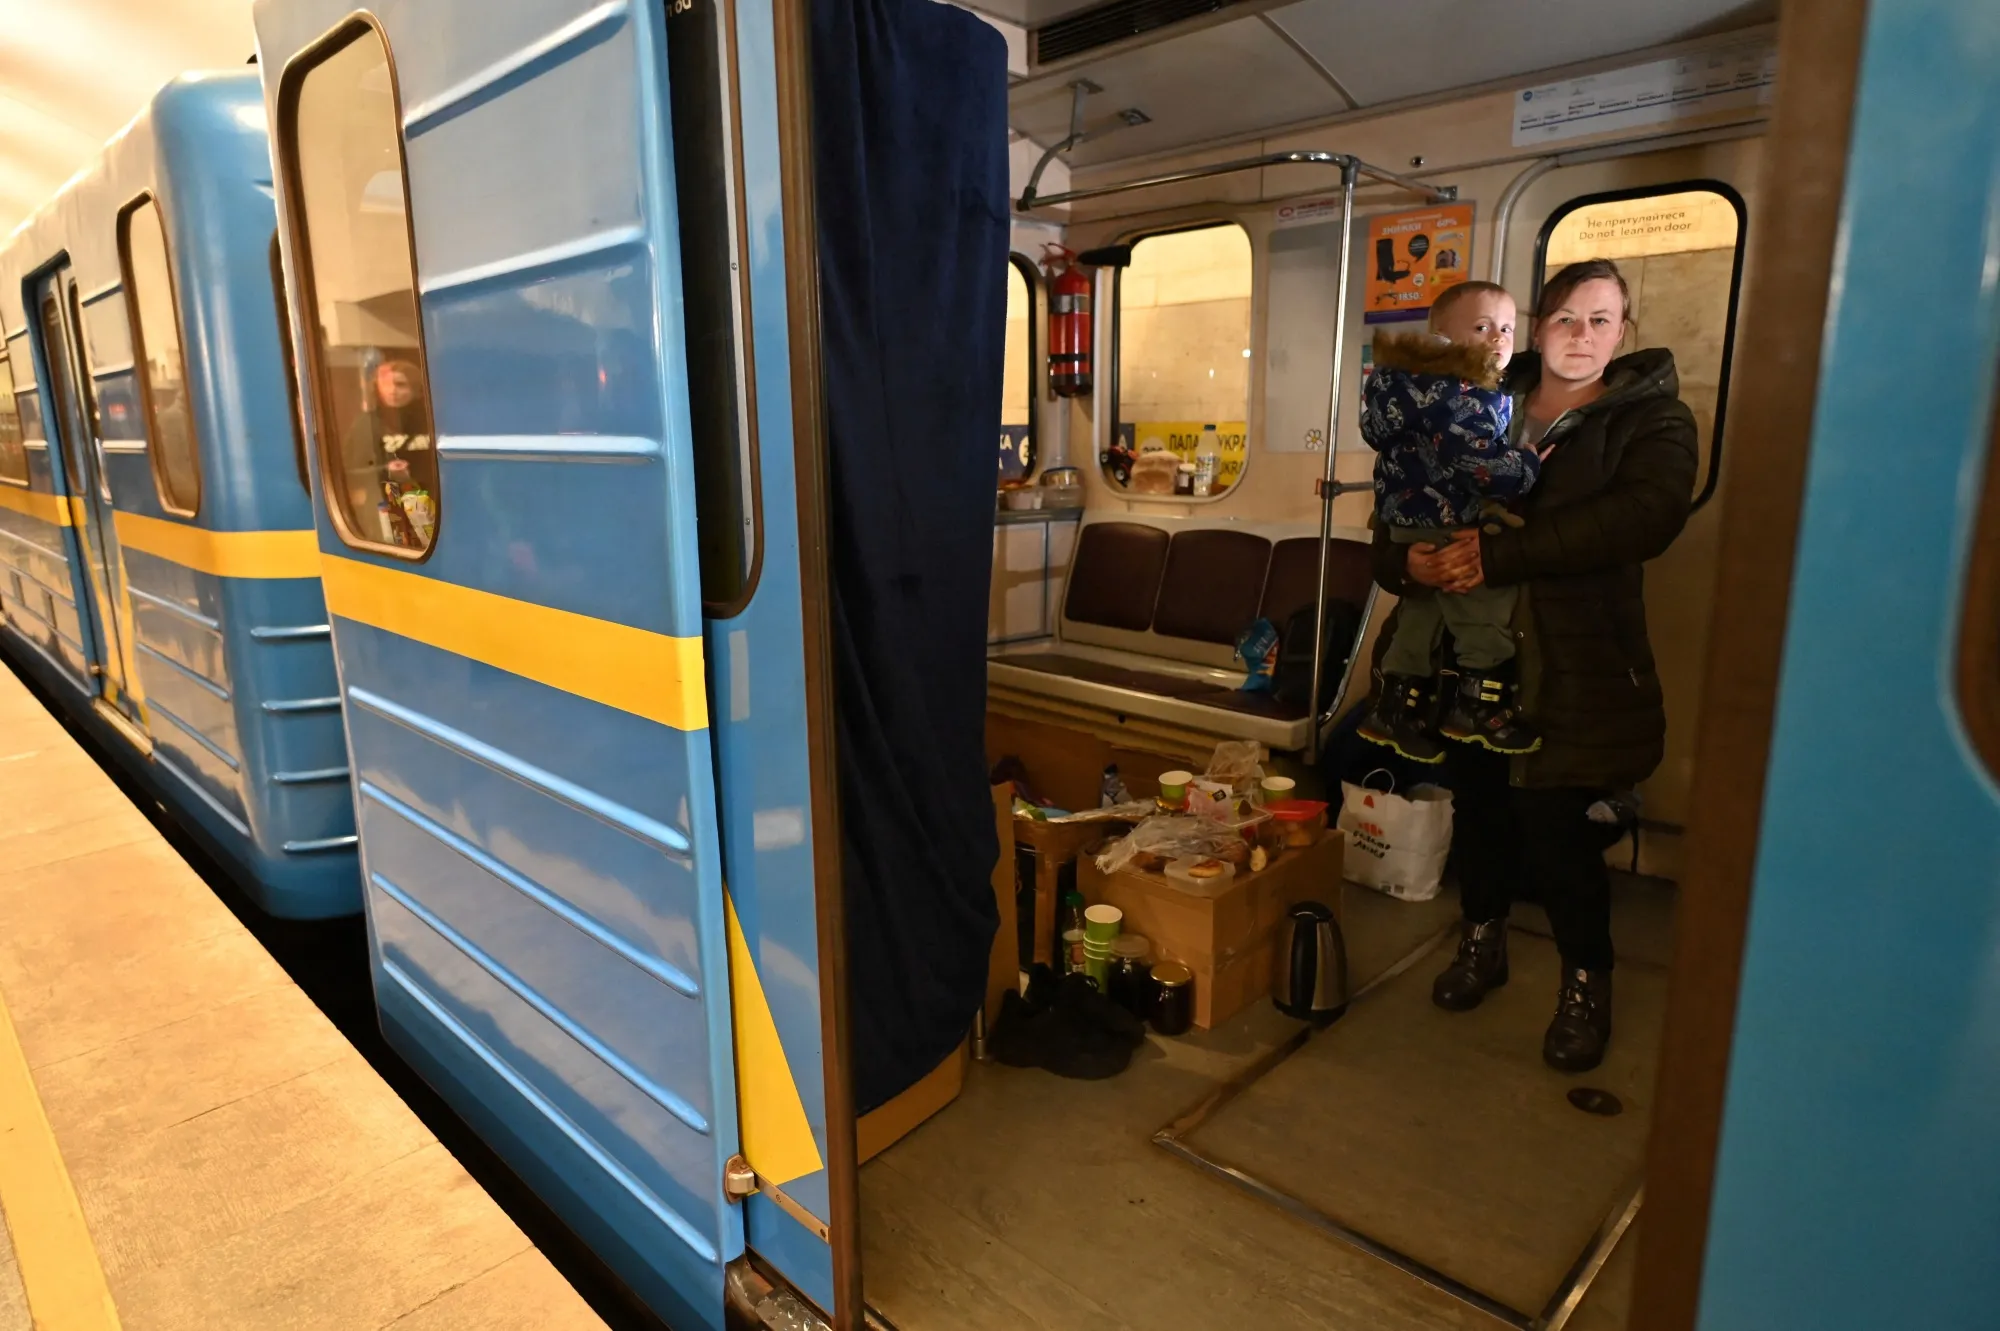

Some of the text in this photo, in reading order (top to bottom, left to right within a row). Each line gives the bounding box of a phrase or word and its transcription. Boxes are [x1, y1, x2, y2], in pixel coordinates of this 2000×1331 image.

[1587, 218, 1602, 228] Не
[1579, 222, 1692, 240] Do not lean on door
